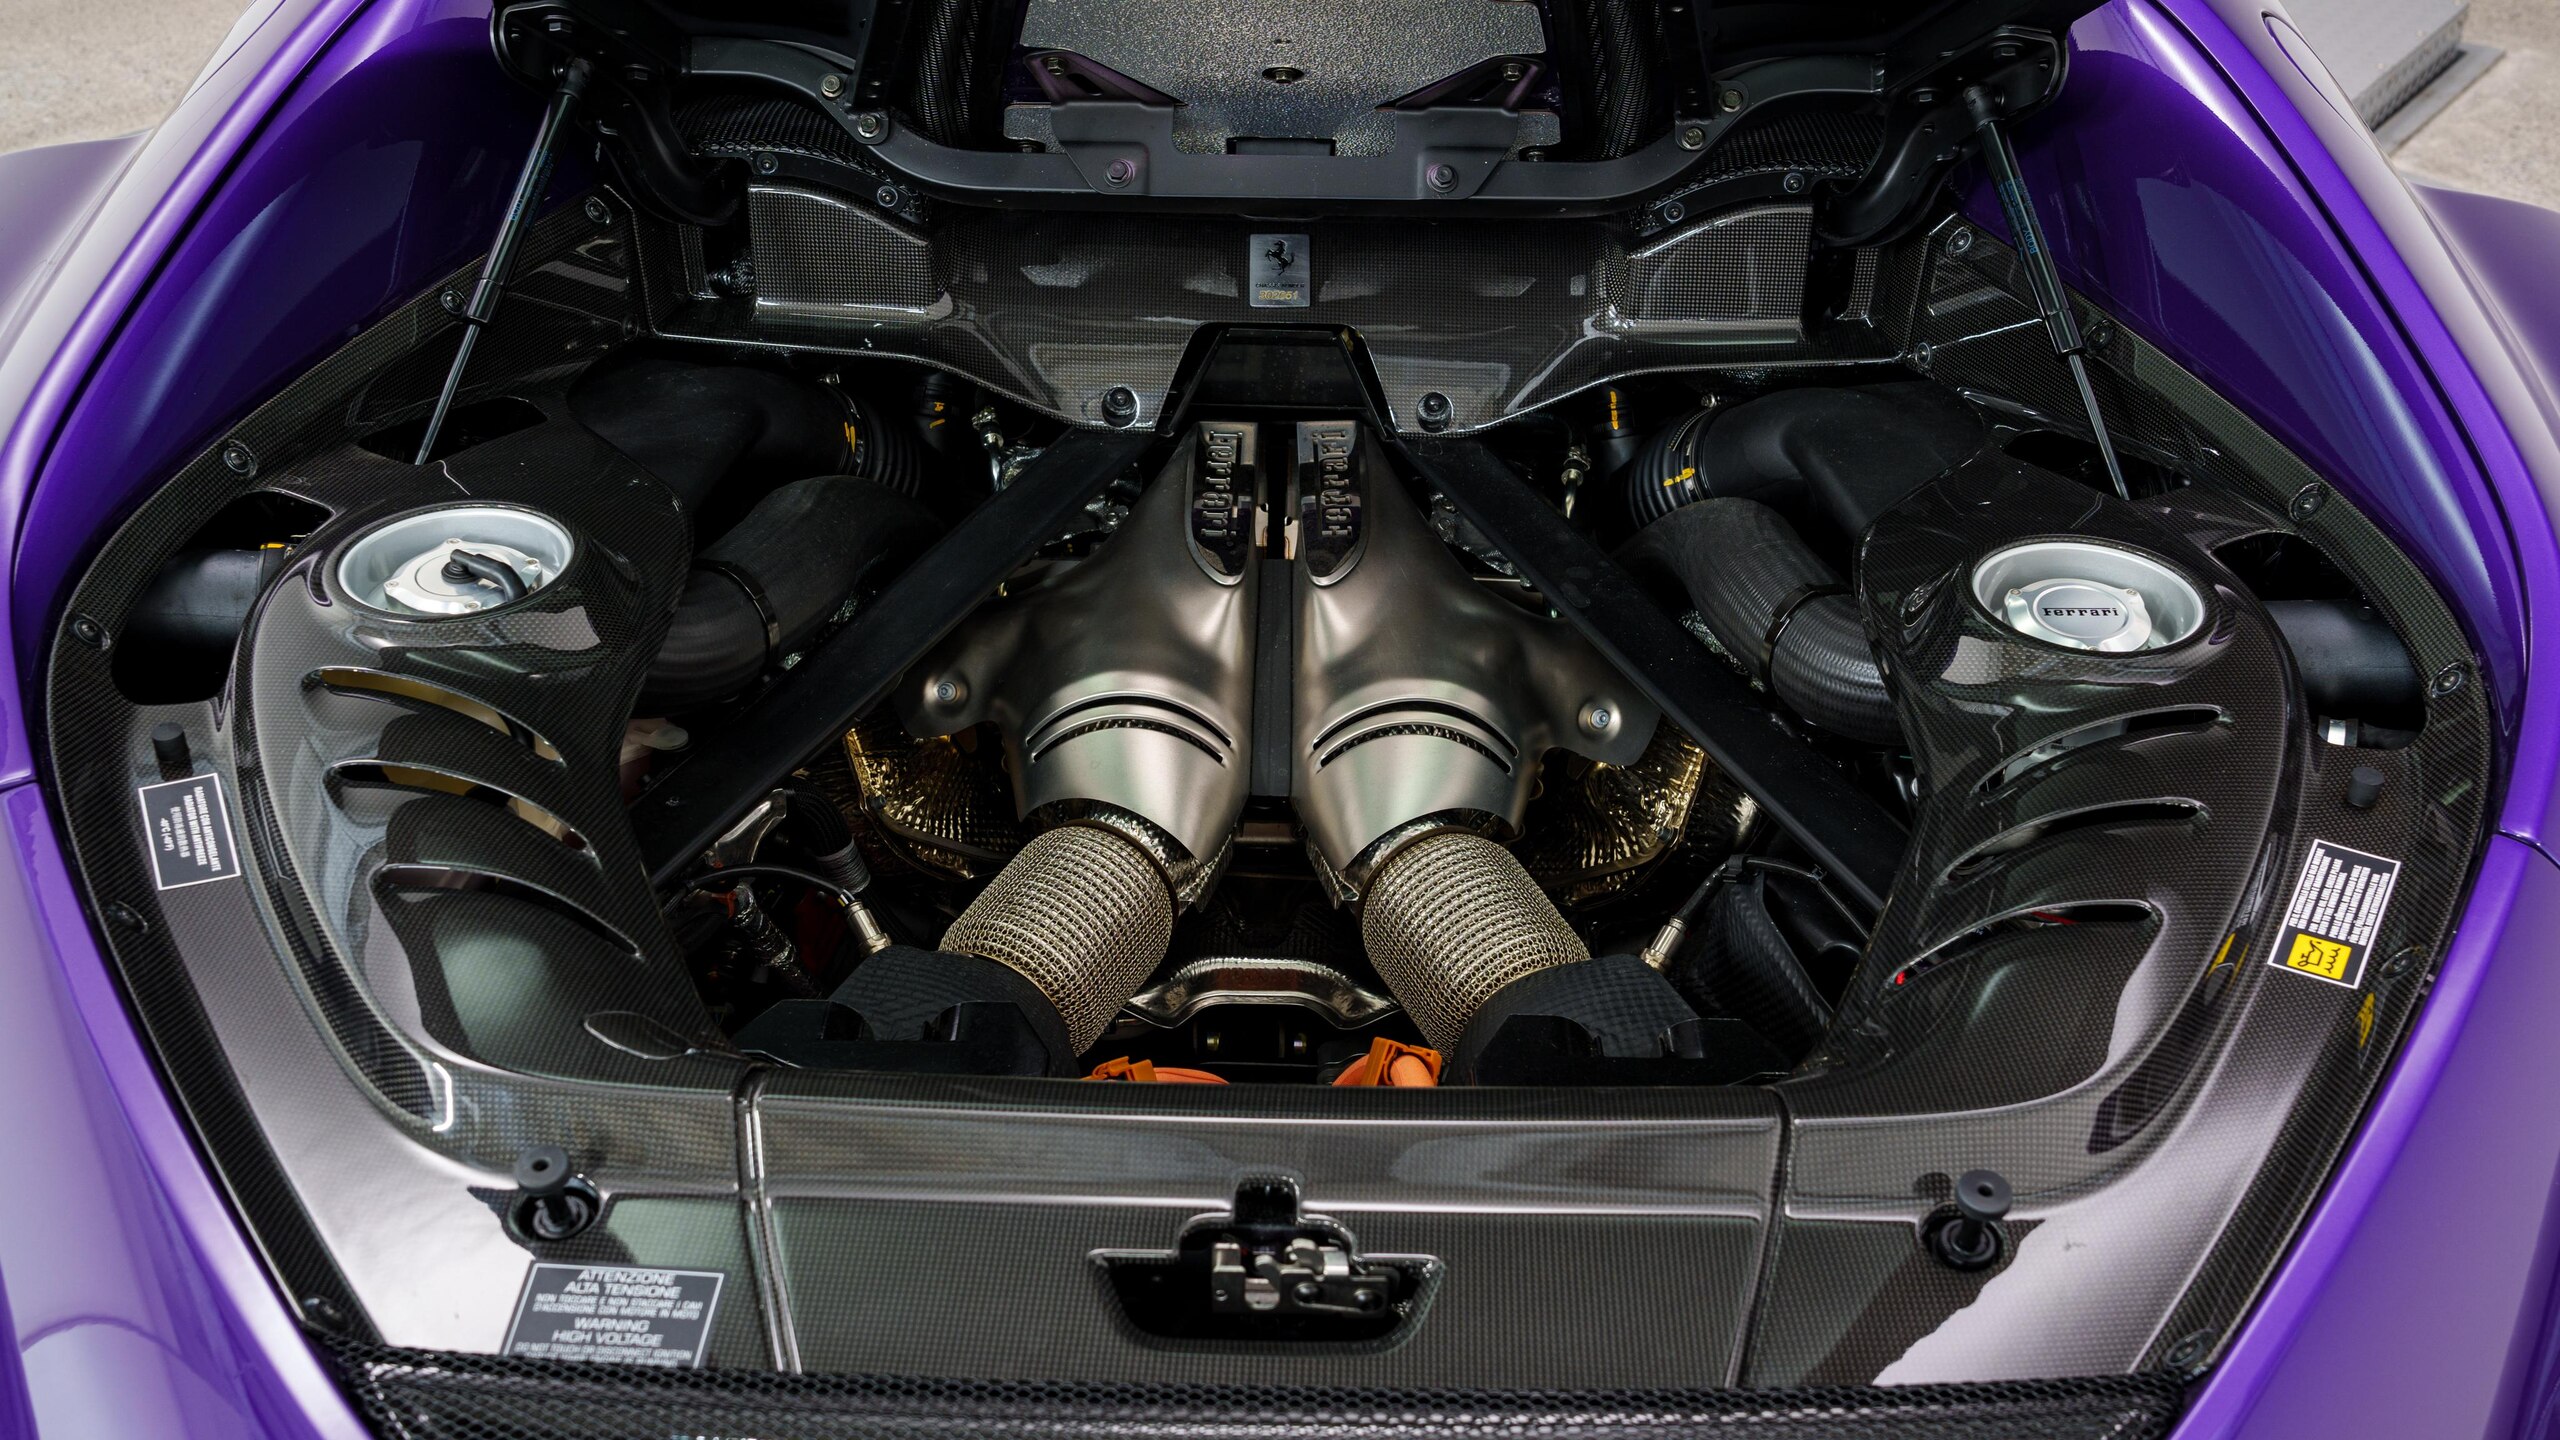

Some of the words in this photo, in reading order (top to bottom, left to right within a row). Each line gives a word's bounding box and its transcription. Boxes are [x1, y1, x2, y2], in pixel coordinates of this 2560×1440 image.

[1200, 430, 1243, 537] Ferrari
[1312, 432, 1352, 537] Ferrari
[2042, 607, 2119, 616] Ferrari
[183, 795, 197, 820] RADIATOR
[194, 786, 208, 815] RADIATORE
[189, 819, 200, 835] WITH
[200, 814, 211, 827] CON
[192, 834, 207, 866] ANTIFREEZE
[202, 826, 221, 871] ANTICONGELANTE
[577, 1268, 677, 1287] ATTENZIONE
[563, 1281, 600, 1294] ALTA
[604, 1282, 682, 1299] TENSIONE
[574, 1317, 650, 1333] WARNING
[552, 1330, 592, 1343] HIGH
[596, 1332, 664, 1347] VOLTAGE
